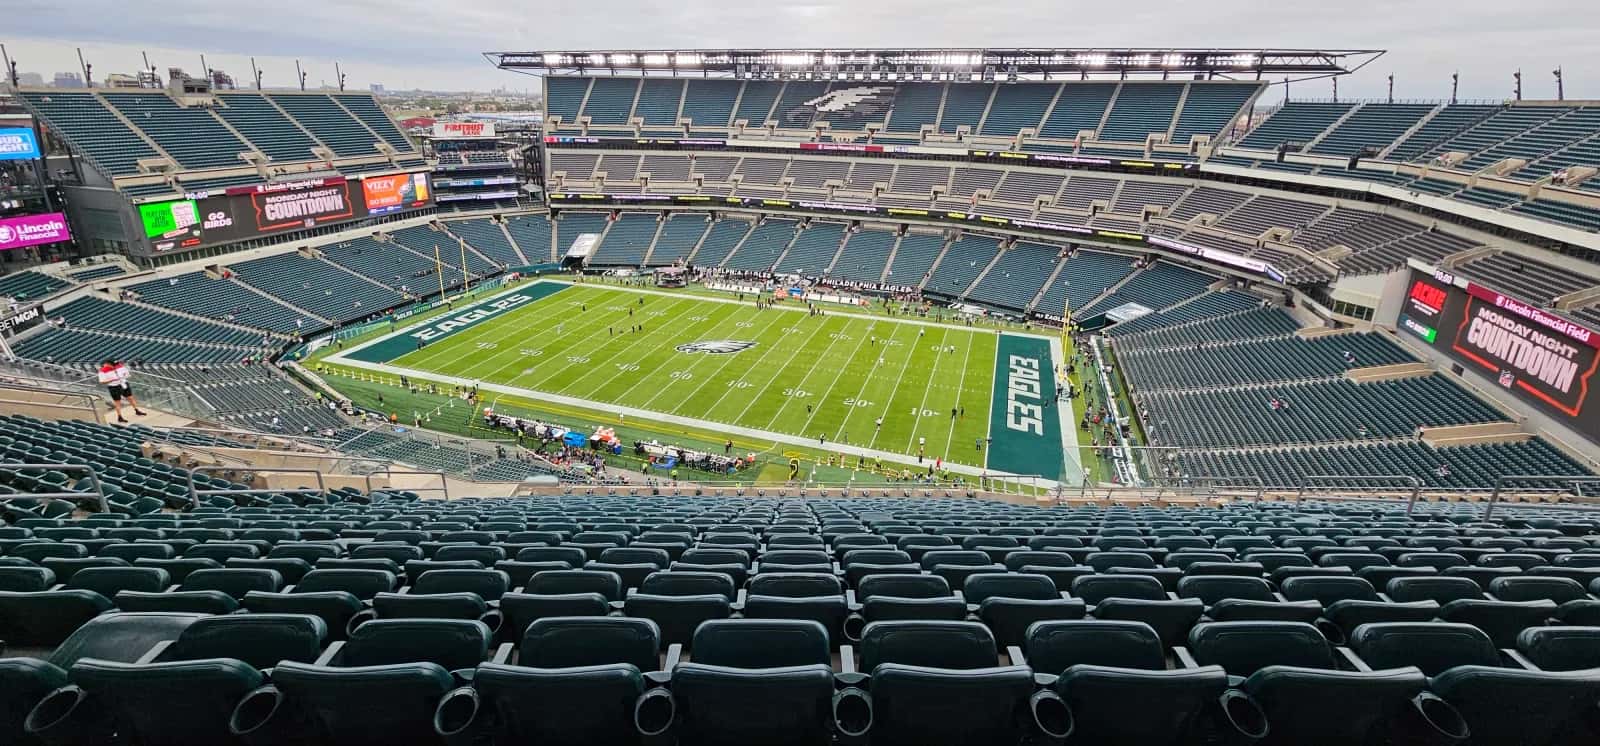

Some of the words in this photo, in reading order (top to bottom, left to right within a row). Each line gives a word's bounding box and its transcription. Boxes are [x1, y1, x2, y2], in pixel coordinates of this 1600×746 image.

[265, 193, 309, 204] MONDAY
[310, 188, 339, 199] NIGHT
[264, 193, 344, 221] COUNTDOWN
[204, 217, 233, 230] BIRDS
[208, 211, 225, 221] GO
[16, 220, 64, 235] Lincoln
[18, 230, 60, 242] Financial
[822, 278, 877, 290] PHILADELPHIA
[1409, 280, 1448, 312] ACME
[410, 294, 533, 341] EAGLES
[1505, 299, 1532, 318] Lincoln
[1530, 310, 1568, 334] Financial
[1566, 324, 1591, 342] Field
[1477, 307, 1532, 338] MONDAY
[1530, 330, 1579, 359] NIGHT
[1467, 317, 1579, 394] COUNTDOWN
[782, 388, 806, 398] 30
[1006, 354, 1044, 437] EAGLES
[843, 398, 869, 408] 20
[911, 407, 934, 417] 10
